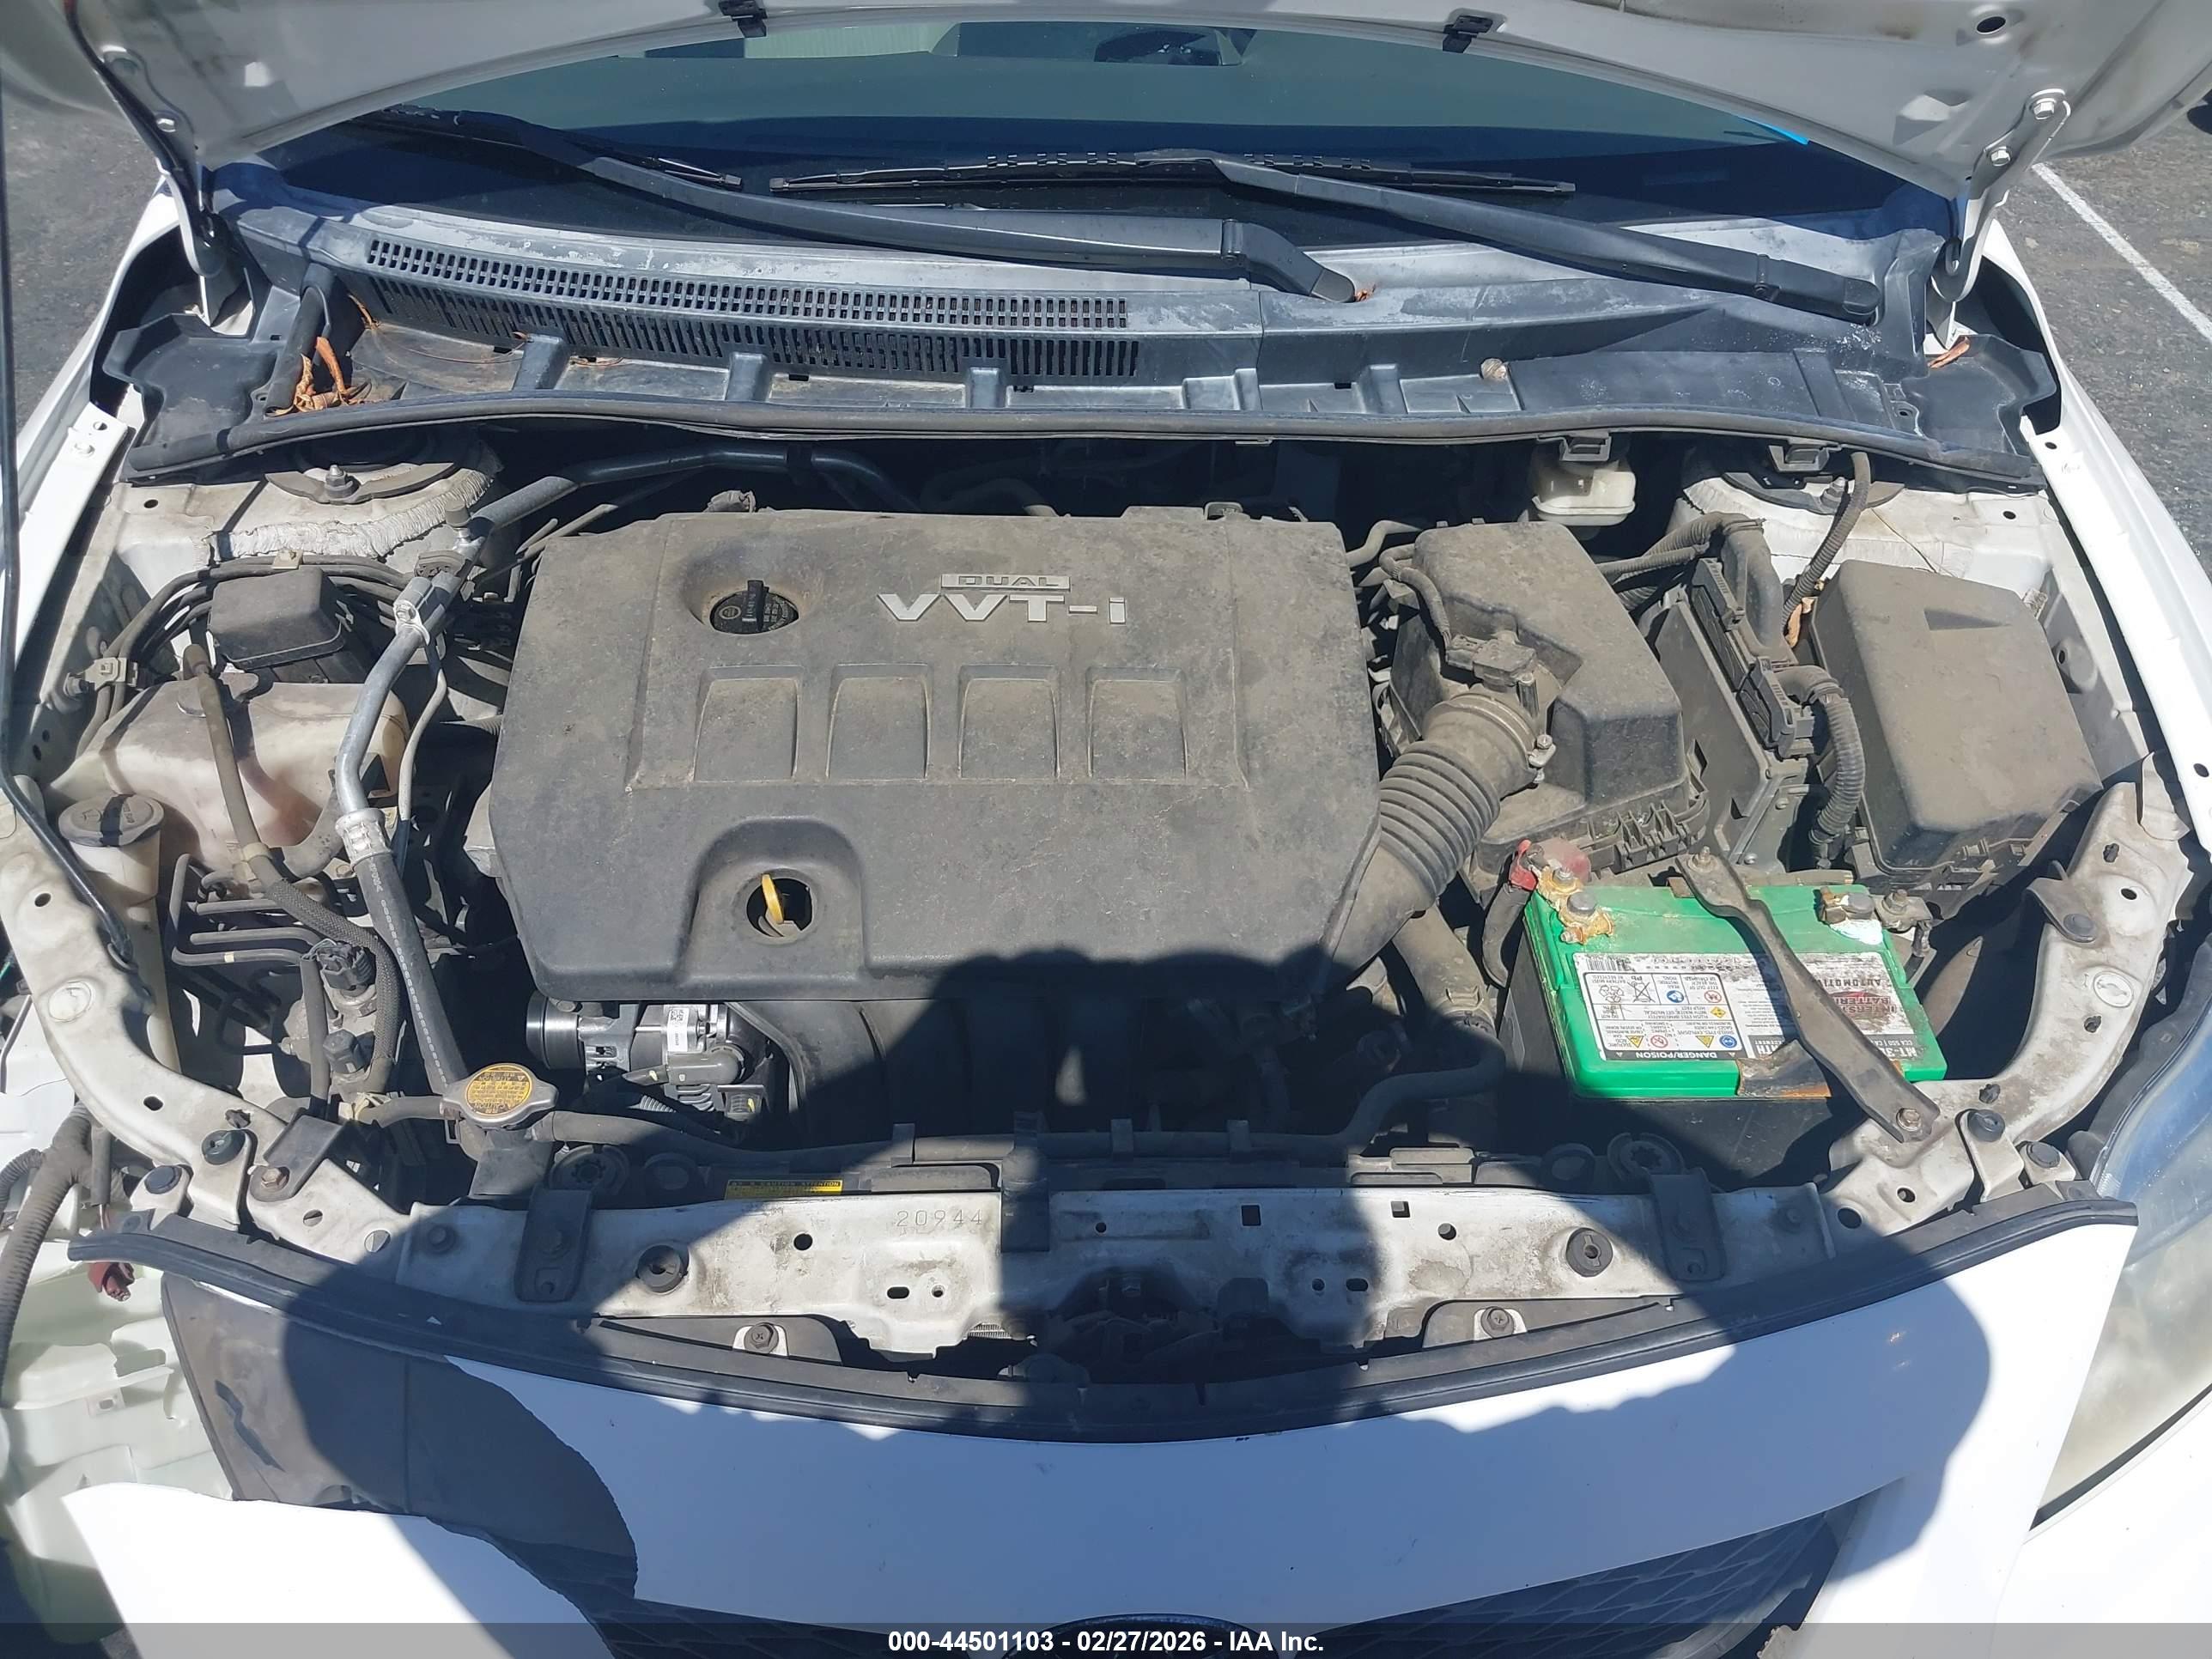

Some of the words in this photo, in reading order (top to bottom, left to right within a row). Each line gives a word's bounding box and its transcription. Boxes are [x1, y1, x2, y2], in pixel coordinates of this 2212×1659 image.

[957, 575, 1060, 587] DUAL
[877, 593, 1126, 624] VVT-i
[1833, 997, 1890, 1006] BATTERI
[896, 1209, 982, 1227] 20944
